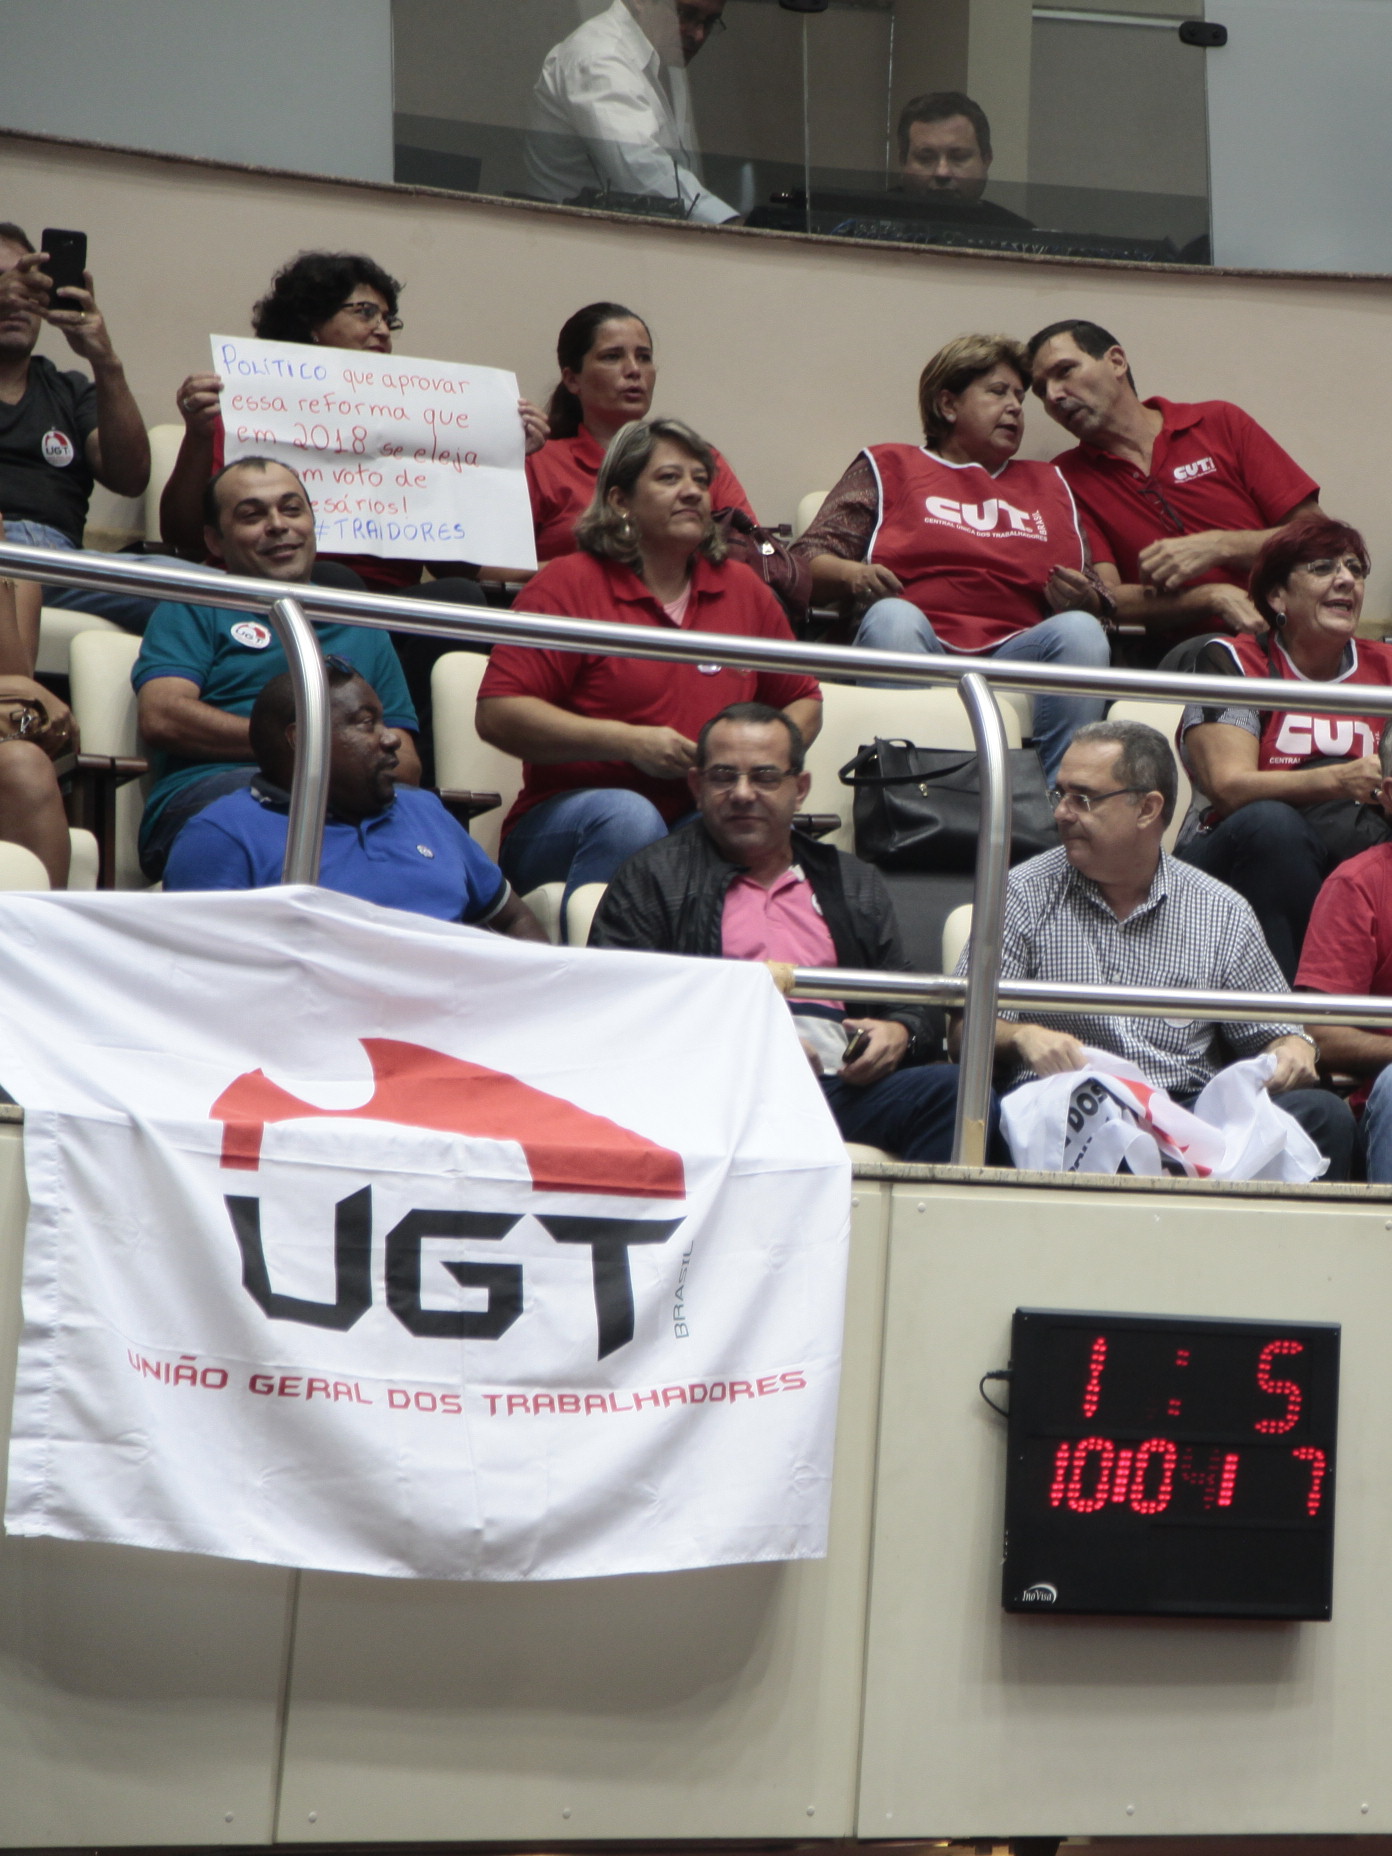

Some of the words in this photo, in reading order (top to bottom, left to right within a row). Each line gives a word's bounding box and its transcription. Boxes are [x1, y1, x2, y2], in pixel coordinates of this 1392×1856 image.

[343, 368, 375, 393] que
[382, 371, 472, 395] aprovar
[231, 393, 288, 412] essa
[423, 408, 470, 436] que
[236, 425, 277, 444] em
[292, 423, 368, 455] 2018
[382, 441, 404, 458] se
[413, 434, 481, 473] eleja
[332, 463, 383, 488] voto
[394, 466, 428, 488] de
[1173, 457, 1209, 480] CUT
[312, 494, 409, 516] esários!
[925, 496, 1030, 531] CUT
[314, 518, 466, 542] #TRAIDORES
[1269, 757, 1301, 765] CENTRA
[223, 1184, 688, 1362] UGT
[673, 1240, 695, 1340] BRASIL
[126, 1348, 229, 1390] UNIÃO
[248, 1373, 373, 1405] GERAL
[387, 1388, 463, 1415] DOS
[481, 1370, 808, 1417] TRABALHADORES
